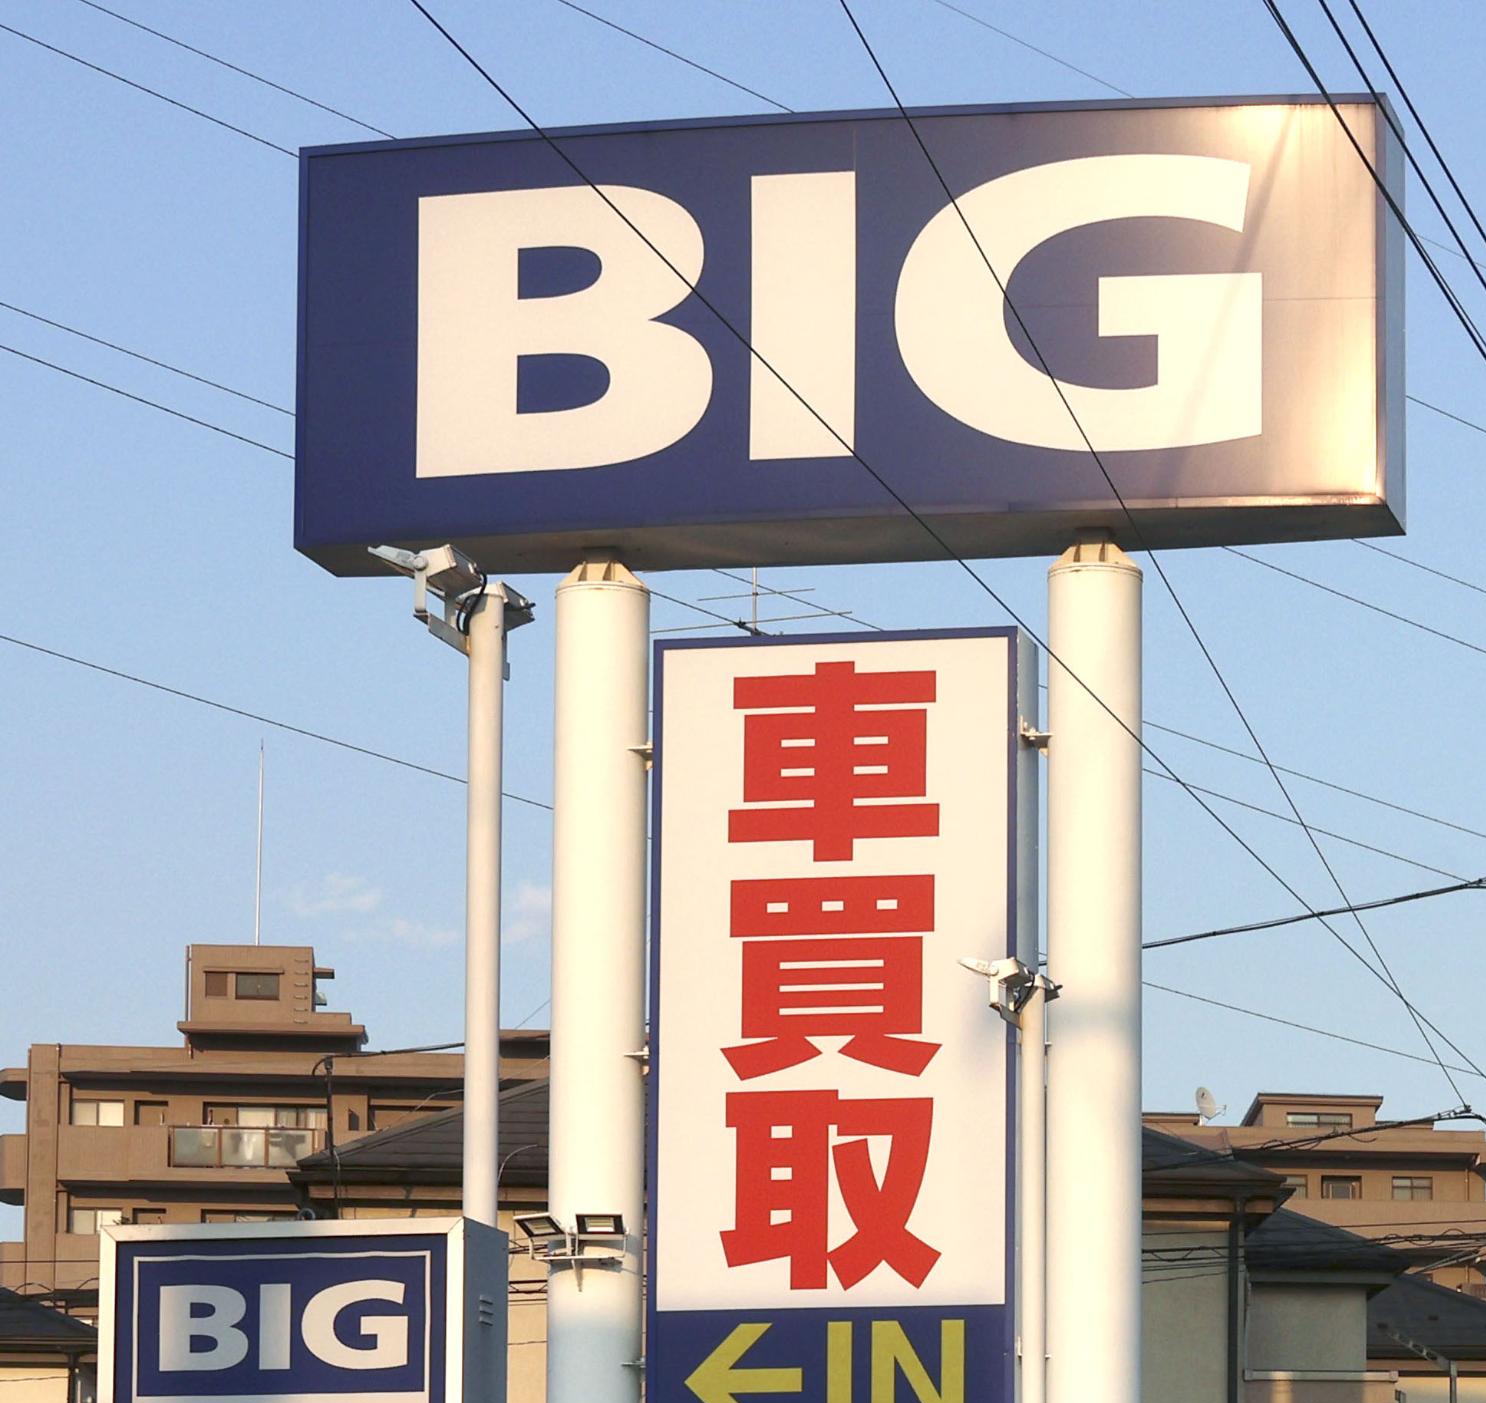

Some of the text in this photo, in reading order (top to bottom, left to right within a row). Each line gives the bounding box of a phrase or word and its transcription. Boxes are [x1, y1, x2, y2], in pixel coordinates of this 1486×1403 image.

[416, 154, 1263, 478] BIG
[721, 662, 942, 1290] 車買取
[159, 1280, 409, 1371] BIG
